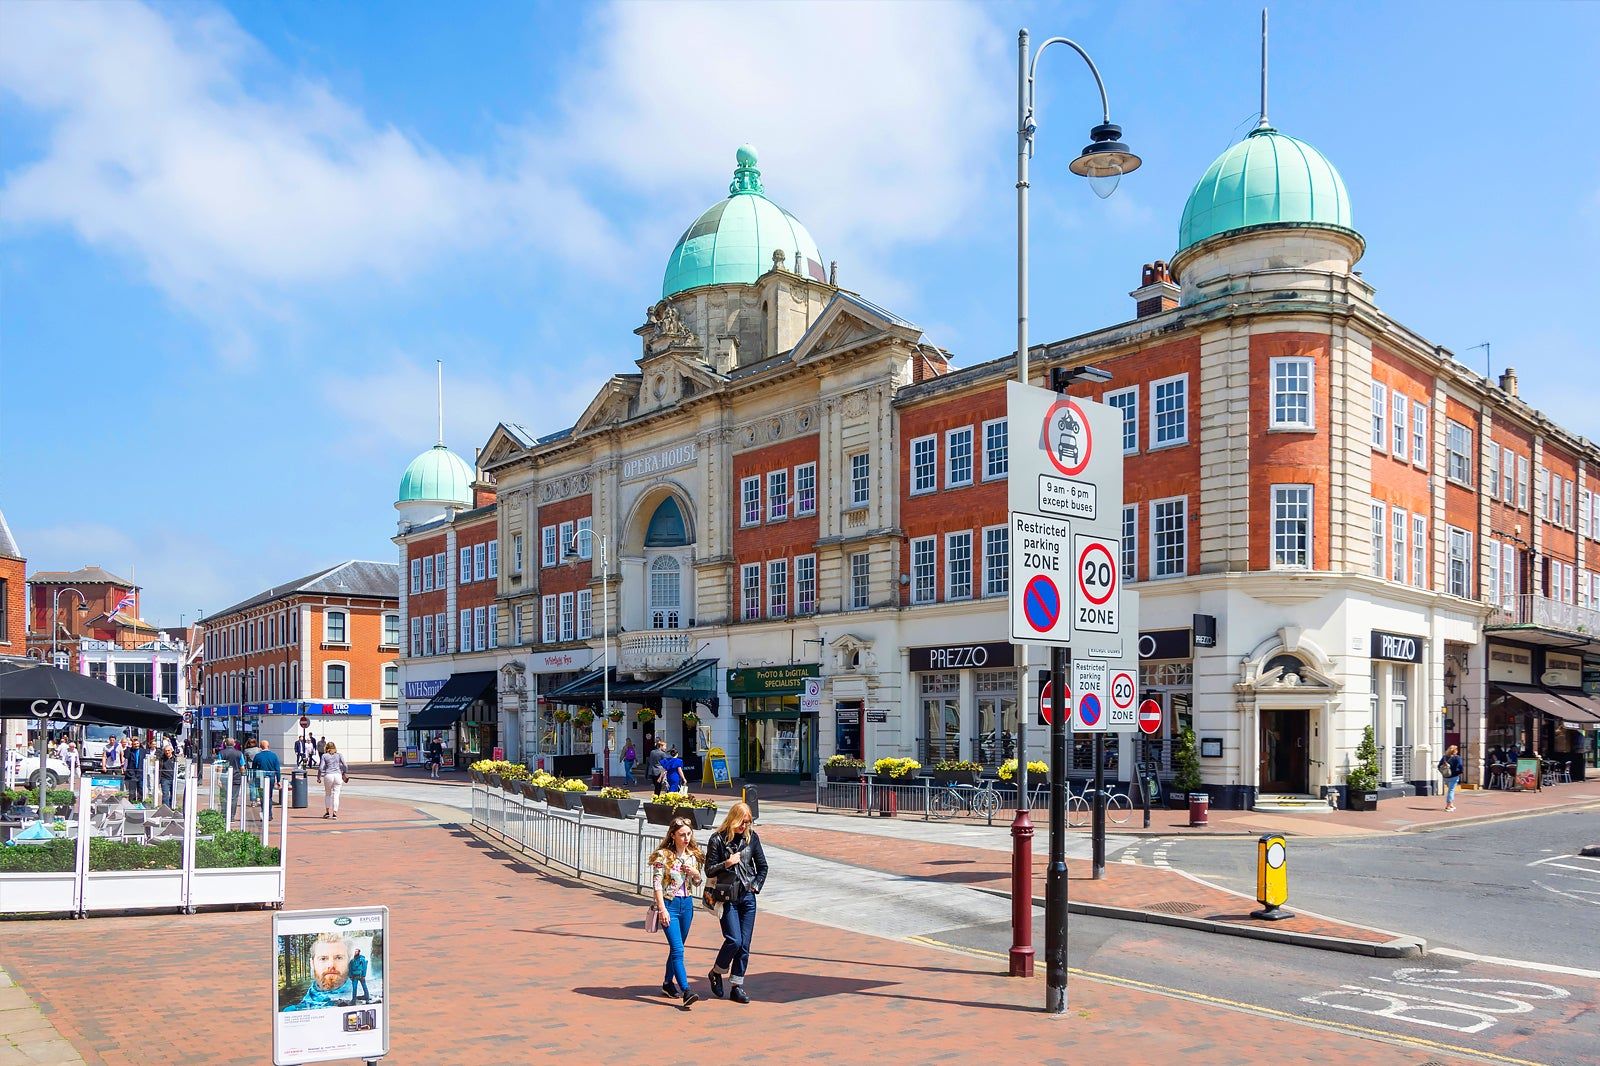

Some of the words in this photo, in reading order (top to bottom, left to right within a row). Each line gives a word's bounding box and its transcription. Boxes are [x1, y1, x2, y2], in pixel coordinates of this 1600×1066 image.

[623, 455, 659, 478] OPERA
[661, 443, 698, 468] HOUSE
[1042, 496, 1069, 510] except
[1071, 499, 1093, 513] buses
[1017, 519, 1066, 538] Restricted
[1024, 538, 1060, 554] parking
[1024, 553, 1060, 571] ZONE
[1084, 560, 1111, 588] 20
[1080, 608, 1114, 625] ZONE
[1382, 635, 1416, 660] PREZZO
[930, 646, 987, 669] PREZZO
[1075, 662, 1105, 672] Restricted
[764, 678, 801, 688] SPECIALISTS
[1079, 672, 1101, 681] parking
[1079, 681, 1101, 691] ZONE
[1115, 684, 1132, 698] 20
[30, 699, 85, 720] CAU
[1112, 711, 1134, 720] ZONE
[1300, 967, 1572, 1034] BUS
